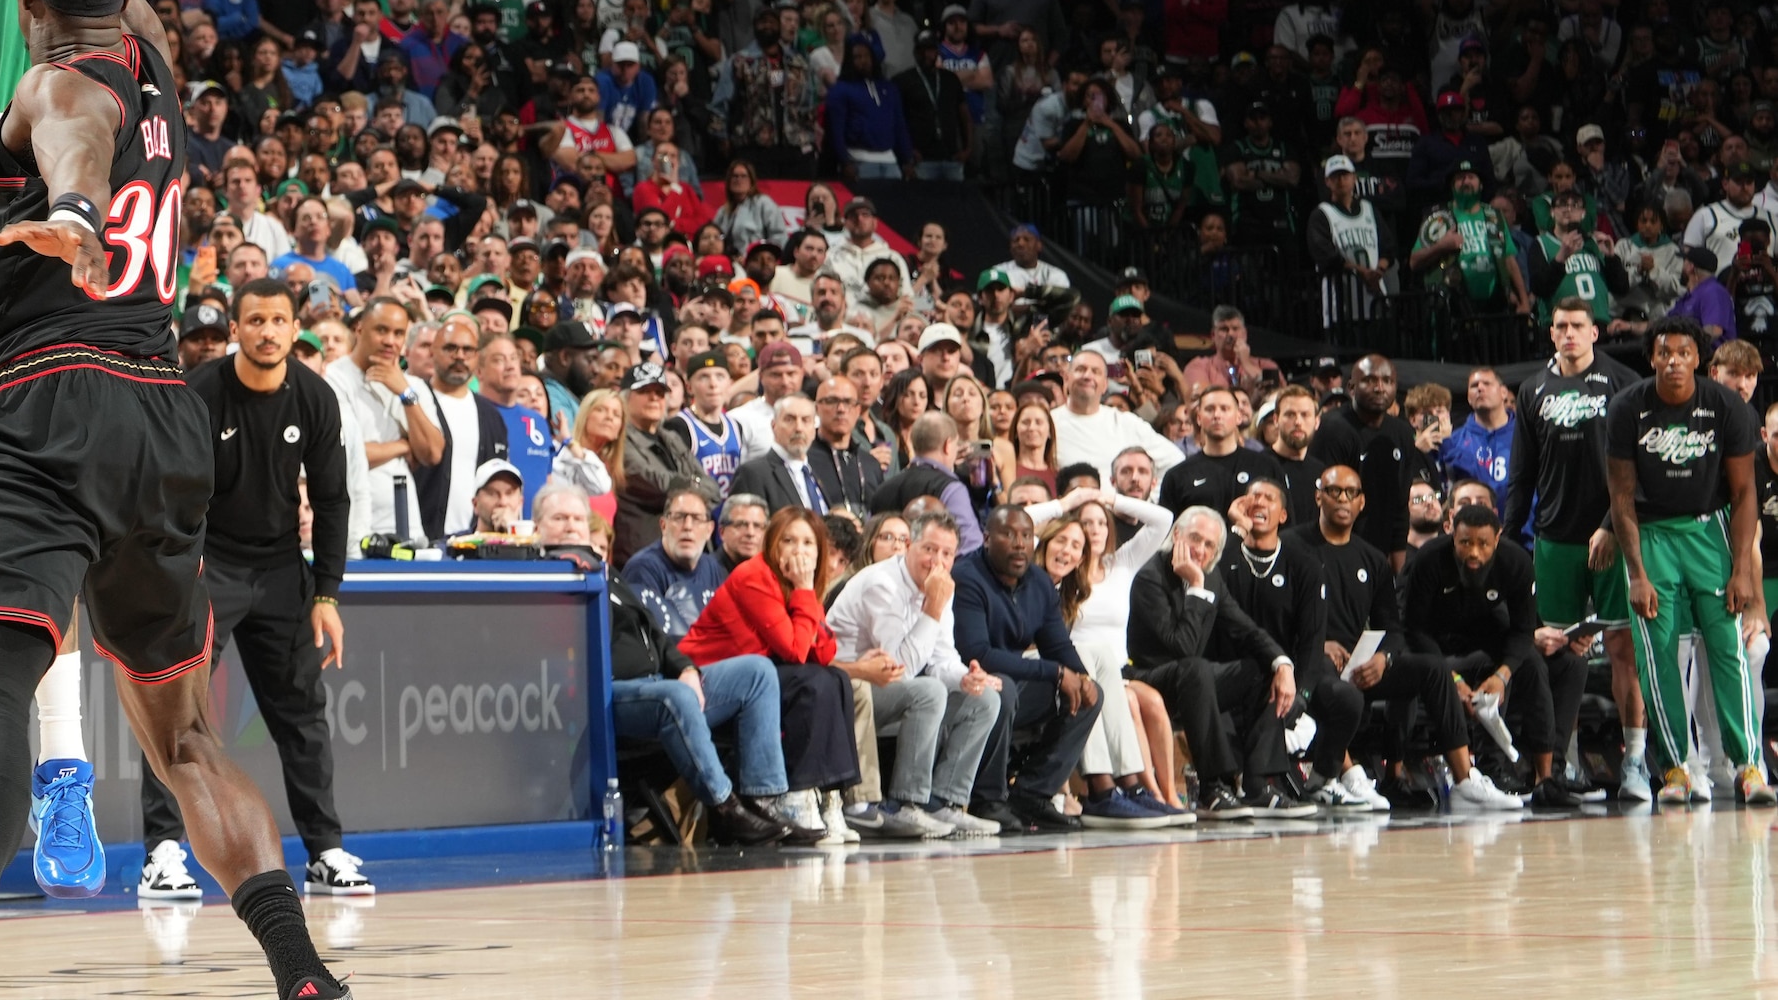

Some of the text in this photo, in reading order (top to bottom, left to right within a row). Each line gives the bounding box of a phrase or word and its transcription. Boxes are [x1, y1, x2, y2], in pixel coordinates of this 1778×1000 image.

[83, 179, 182, 305] 30
[1574, 273, 1596, 300] 0
[521, 416, 545, 447] 76
[1638, 426, 1716, 455] Different
[398, 658, 564, 769] peacock
